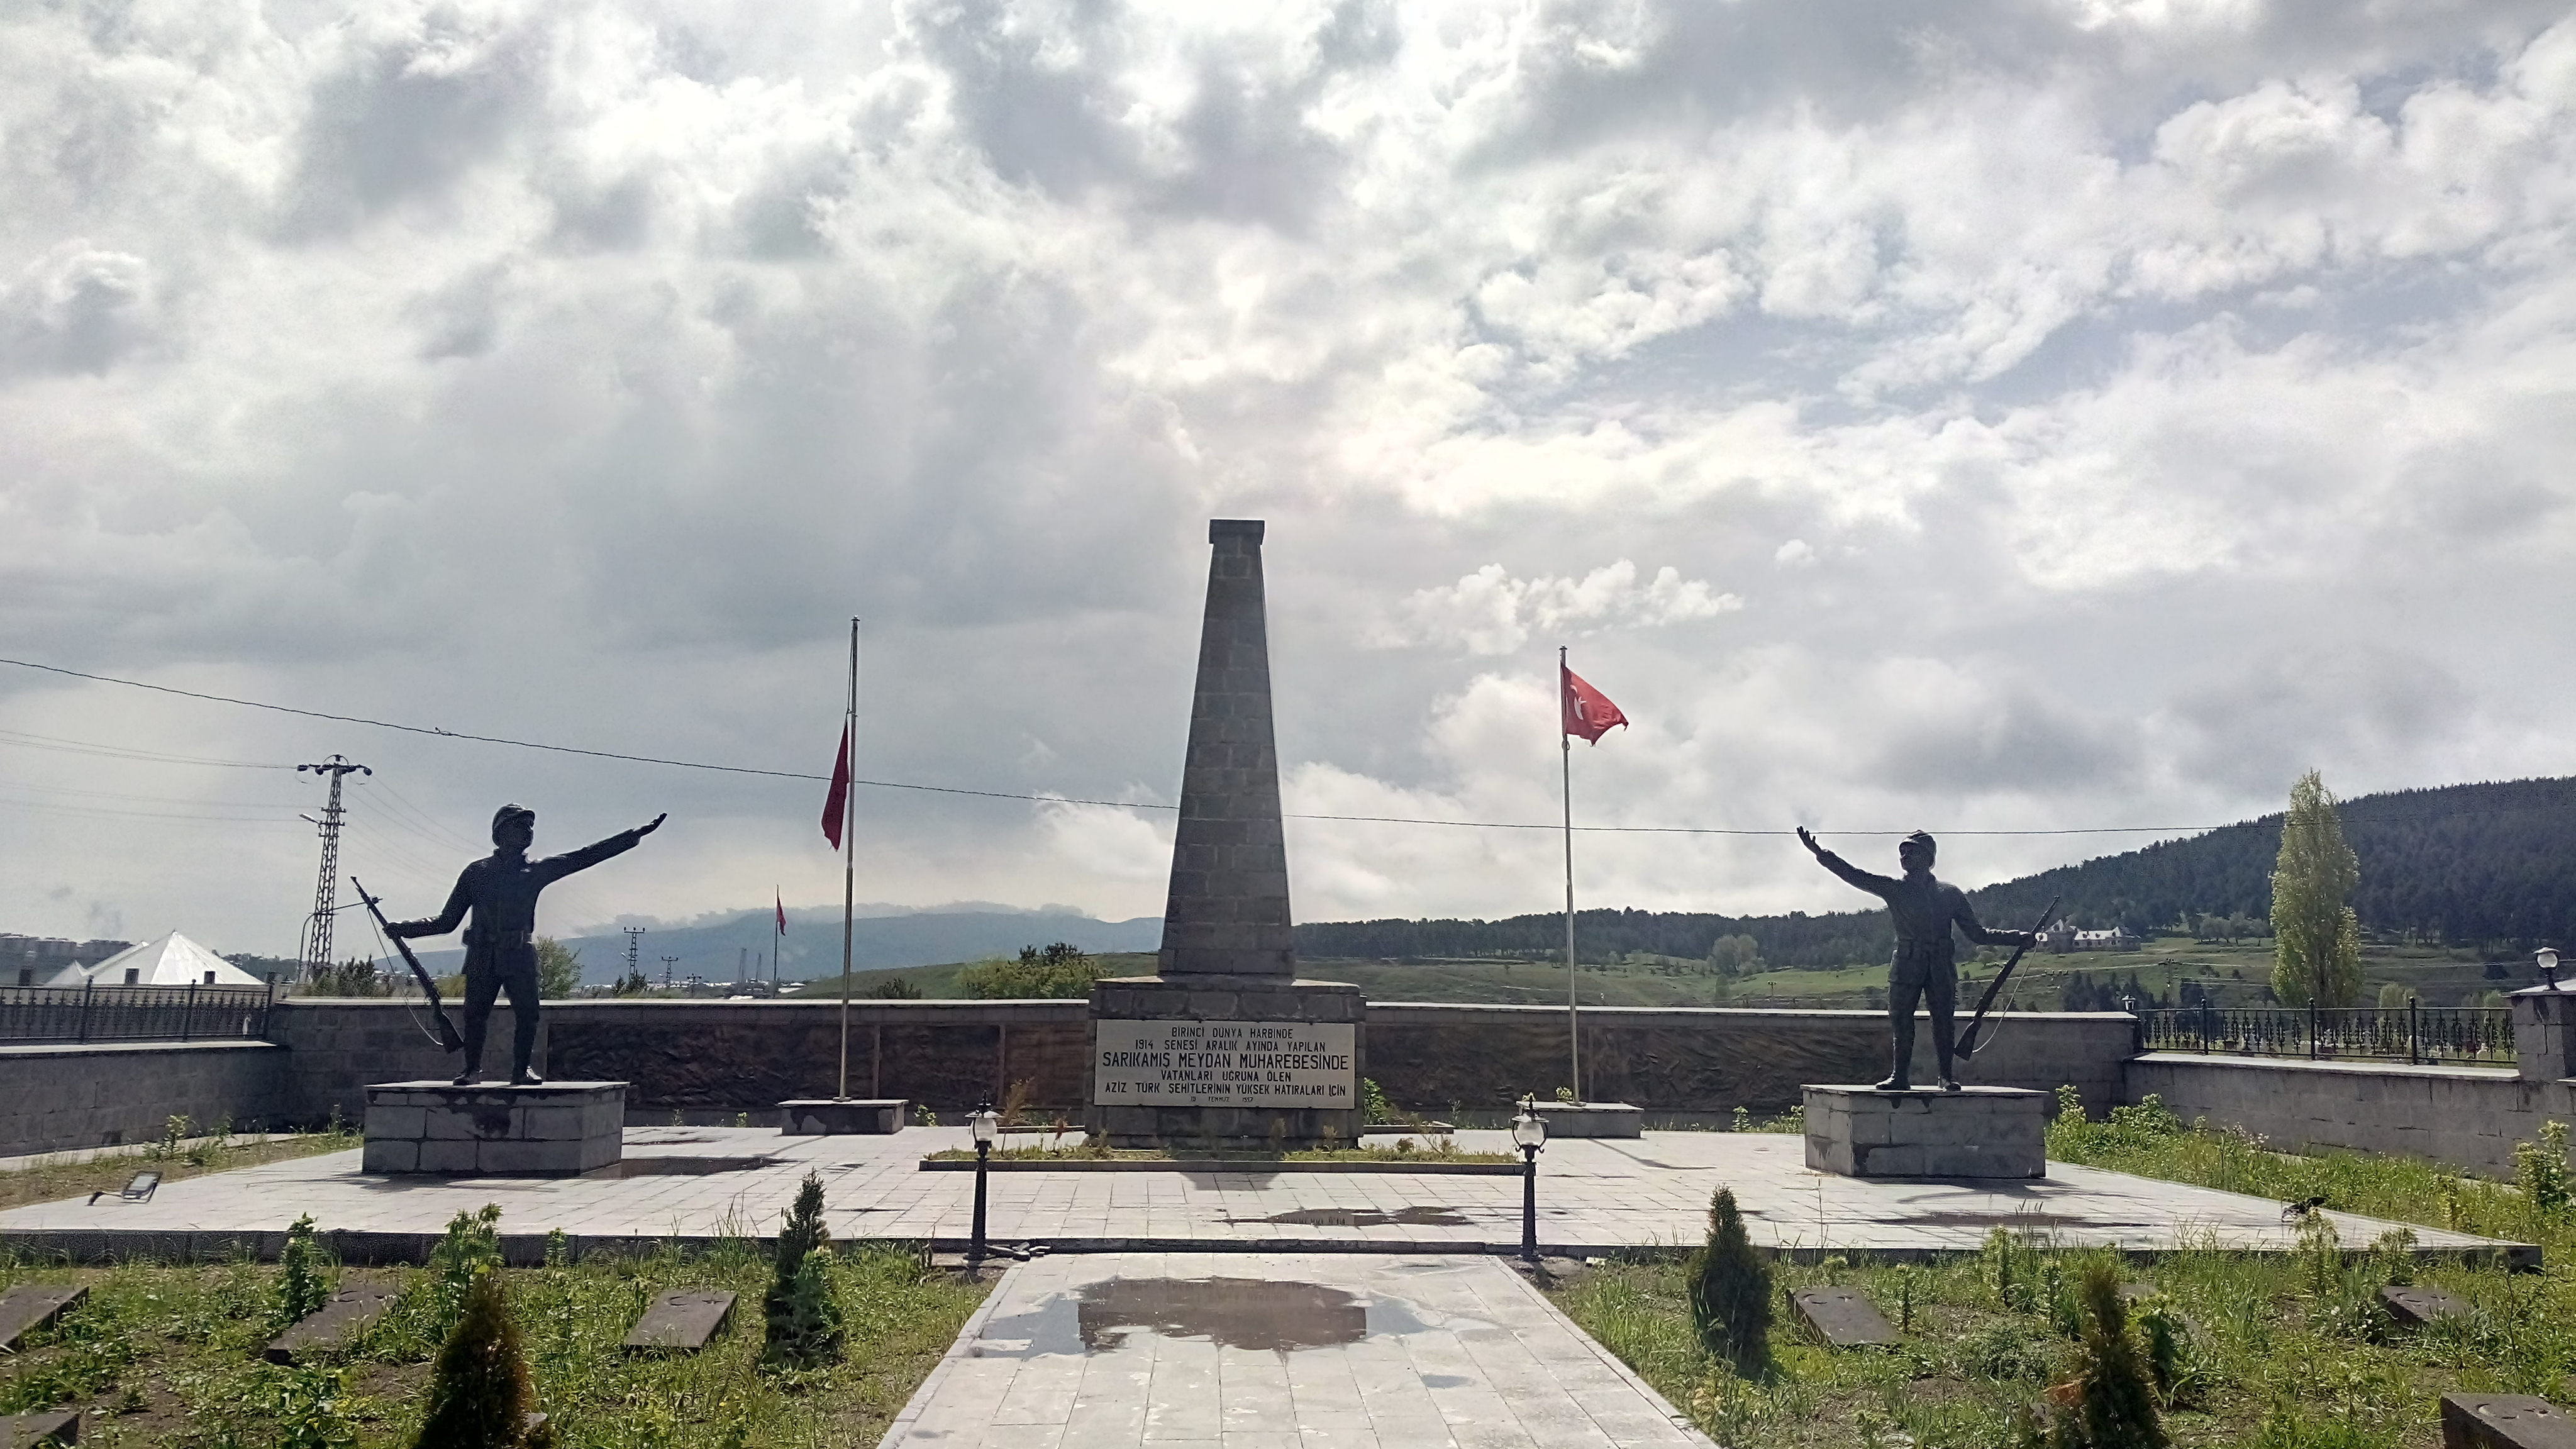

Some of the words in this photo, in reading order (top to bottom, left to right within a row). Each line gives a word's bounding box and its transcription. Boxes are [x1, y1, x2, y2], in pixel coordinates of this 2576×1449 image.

[1135, 1039, 1153, 1050] 1914
[1206, 1040, 1237, 1052] ARALIK
[1246, 1041, 1279, 1052] AYINDA
[1287, 1041, 1325, 1052] YAPILAN
[1102, 1052, 1170, 1069] SARIKAMIŞ
[1179, 1053, 1231, 1069] MEYDAN
[1240, 1053, 1348, 1070] MUHAREBESİNDE
[1161, 1070, 1213, 1081] VATANLARI
[1267, 1070, 1291, 1082] ÖLEN
[1105, 1081, 1127, 1093] AZİZ
[1274, 1084, 1324, 1096] HATIRALARI
